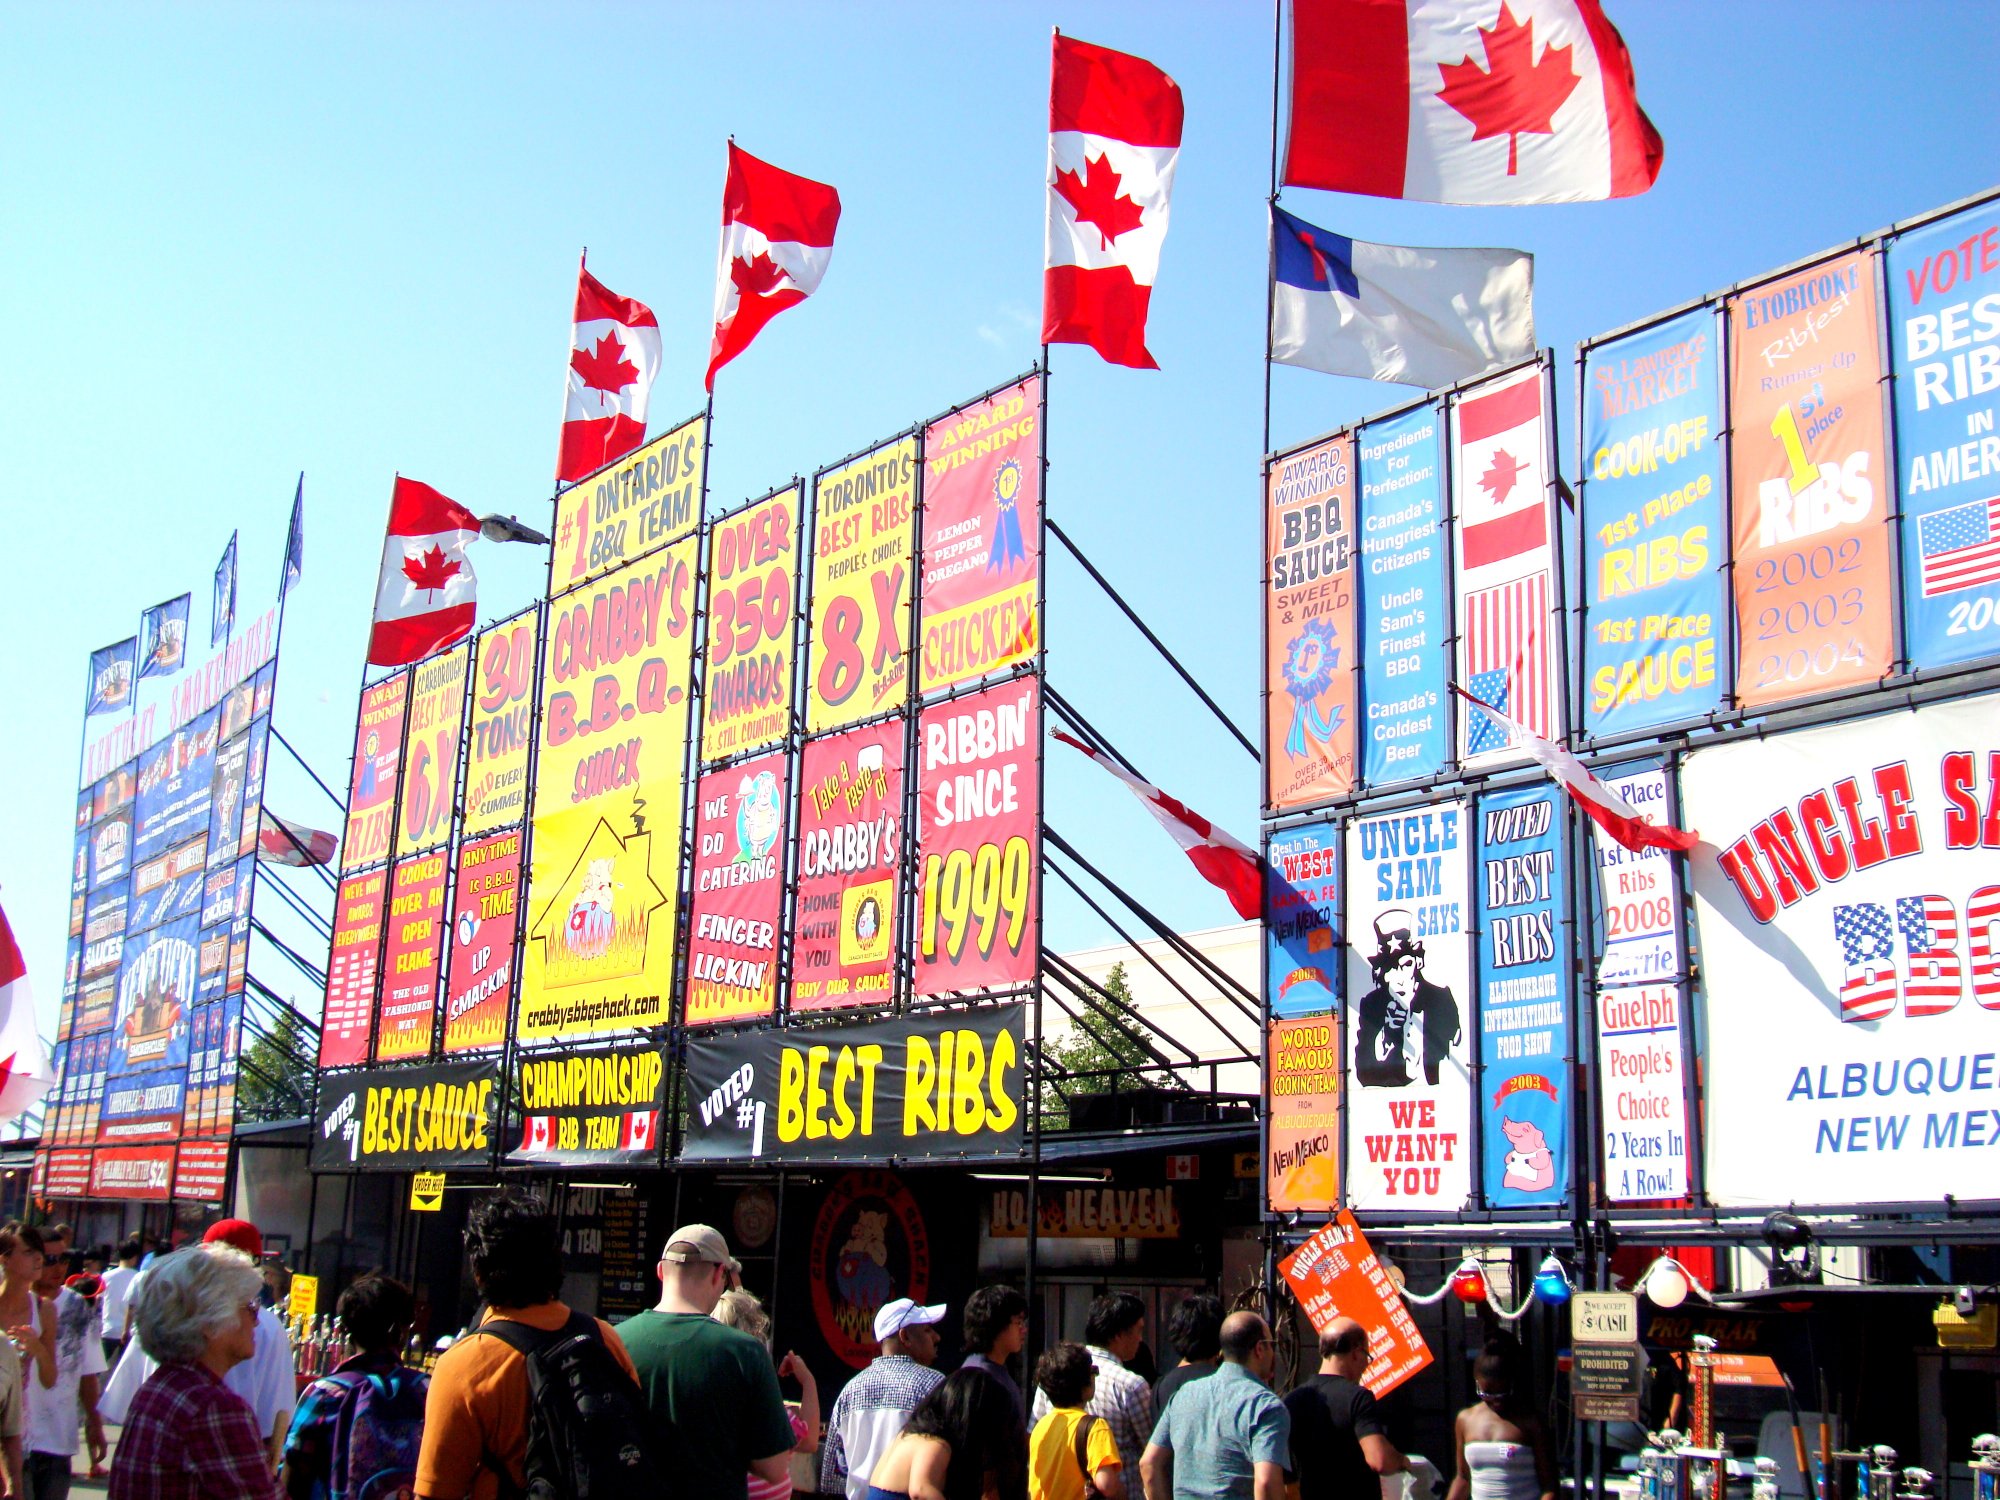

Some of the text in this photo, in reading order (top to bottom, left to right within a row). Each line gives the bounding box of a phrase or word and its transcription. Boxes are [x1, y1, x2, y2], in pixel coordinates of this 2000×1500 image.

[1745, 261, 1860, 331] ETOBICOKE
[1760, 290, 1852, 369] Ribfest
[1602, 357, 1702, 421] MARKET
[940, 396, 1025, 450] AWARD
[930, 416, 1035, 478] WINNING
[1361, 424, 1434, 461] Ingredients
[1594, 415, 1709, 481] COOK-OFF
[595, 431, 696, 524] ONTARIO'S
[1281, 446, 1341, 484] AWARD
[1363, 466, 1434, 499] Perfection:
[1387, 455, 1410, 473] For
[823, 451, 912, 518] TORONTO'S
[1274, 465, 1347, 507] WINNING
[589, 482, 694, 570] BBQ TEAM
[819, 490, 911, 558] BEST RIBS
[937, 515, 982, 543] LEMON
[1281, 496, 1343, 550] BBQ
[1366, 499, 1434, 532] Canada's
[1597, 473, 1712, 548] 1st Place
[717, 503, 791, 580] OVER
[934, 534, 983, 563] PEPPER
[1362, 518, 1437, 555] Hungriest
[828, 536, 903, 582] PEOPLE'S CHOICE
[926, 550, 989, 585] OREGANO
[1272, 535, 1350, 591] SAUCE
[1371, 546, 1431, 575] Citizens
[1598, 524, 1710, 602] RIBS
[1754, 537, 1862, 594] 2002
[1276, 578, 1343, 610] SWEET
[1301, 593, 1350, 620] MILD
[1381, 587, 1424, 611] Uncle
[553, 551, 690, 684] CRABBY'S
[711, 566, 791, 667] 350
[1380, 608, 1426, 633] Sam's
[1595, 611, 1712, 644] 1st Place
[1757, 587, 1865, 641] 2003
[924, 591, 1034, 682] CHICKEN
[1379, 631, 1427, 656] Finest
[416, 654, 466, 697] SCARBOROUGH'S
[478, 626, 532, 714] 30
[872, 657, 906, 699] IN-A-ROW
[1385, 655, 1421, 679] BBQ
[1591, 638, 1716, 713] SAUCE
[1756, 640, 1866, 689] 2004
[547, 656, 684, 747] B.B.Q.
[709, 649, 786, 727] AWARDS
[1368, 690, 1438, 719] Canada's
[412, 696, 436, 733] BEST
[475, 703, 528, 763] TONS
[717, 711, 784, 750] STILL COUNTING
[926, 690, 1032, 772] RIBBIN'
[1374, 714, 1433, 741] Coldest
[571, 736, 643, 804] SHACK
[1294, 759, 1318, 780] OVER
[1385, 742, 1422, 764] Beer
[468, 766, 526, 816] SOLD EVERY
[479, 789, 523, 817] SUMMER
[704, 794, 729, 822] WE
[808, 766, 874, 822] Take taste
[933, 763, 1019, 827] SINCE
[345, 805, 393, 860] RIBS
[1359, 810, 1458, 861] UNCLE
[1485, 800, 1553, 847] VOTED
[1716, 759, 1923, 925] UNCLE
[462, 836, 518, 869] ANYTIME
[702, 832, 725, 858] DO
[803, 809, 897, 880] CRABBY'S
[398, 858, 443, 888] COOKED
[700, 854, 777, 893] CATERING
[1283, 847, 1335, 884] WEST
[1377, 856, 1442, 902] SAM
[1487, 849, 1555, 911] BEST
[1619, 869, 1656, 895] Ribs
[391, 884, 445, 918] OVER AN
[469, 878, 480, 895] IS
[480, 888, 515, 921] TIME
[802, 891, 840, 914] HOME
[921, 835, 1030, 965] 1999
[401, 917, 432, 944] OPEN
[697, 912, 775, 951] FINGER
[802, 918, 836, 943] WITH
[1417, 902, 1460, 937] SAYS
[1606, 896, 1672, 936] 2008
[84, 936, 124, 971] SAUCES
[335, 923, 379, 948] EVERYWHERE
[1490, 908, 1555, 969] RIBS
[396, 947, 433, 975] FLAME
[471, 946, 491, 976] LIP
[693, 952, 769, 992] LICKIN'
[804, 949, 832, 970] YOU
[392, 984, 429, 1000] THE OLD
[797, 972, 890, 999] BUY OUR SAUCE
[384, 1000, 432, 1017] FASHIONED
[398, 1018, 418, 1031] WAY
[527, 994, 660, 1031] crabbysbbqshack.com
[1483, 1000, 1563, 1033] INTERNATIONAL
[1602, 988, 1675, 1035] Guelph
[1280, 1026, 1330, 1050] WORLD
[1497, 1031, 1552, 1060] FOOD SHOW
[1277, 1048, 1333, 1072] FAMOUS
[1610, 1045, 1673, 1084] People's
[522, 1050, 663, 1109] CHAMPIONSHIP
[700, 1062, 755, 1128] VOTED
[777, 1028, 1018, 1143] BEST RIBS
[1273, 1072, 1337, 1096] COOKING TEAM
[324, 1092, 356, 1140] VOTED
[362, 1078, 492, 1155] BEST SAUCE
[1389, 1099, 1435, 1129] WE
[1617, 1090, 1670, 1121] Choice
[557, 1114, 621, 1151] RIB TEAM
[1364, 1133, 1458, 1163] WANT
[1608, 1129, 1684, 1159] 2 Years In
[1815, 1113, 1910, 1154] NEW
[414, 1176, 445, 1192] ORDER HERE
[1383, 1167, 1441, 1196] YOU
[1067, 1185, 1174, 1228] HEAVEN
[1290, 1224, 1355, 1281] UNCLE SAM'S
[1598, 1314, 1627, 1332] CASH
[1581, 1359, 1629, 1371] PROHIBITED
